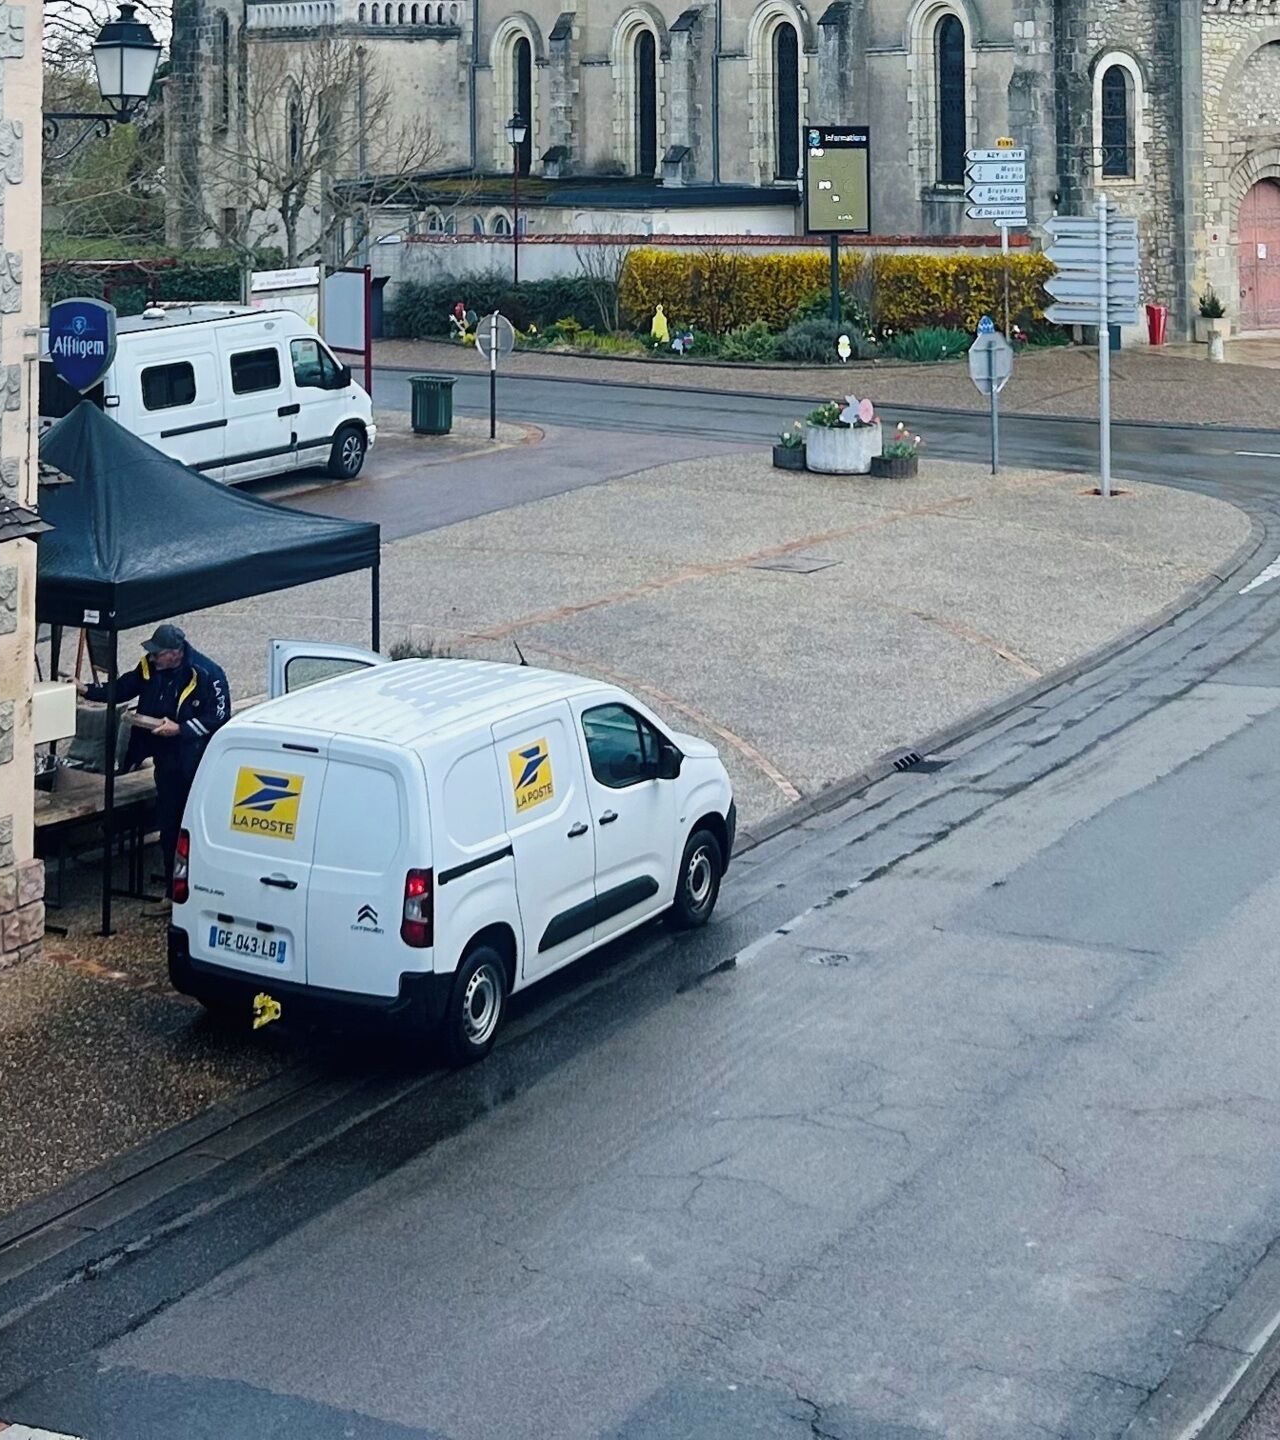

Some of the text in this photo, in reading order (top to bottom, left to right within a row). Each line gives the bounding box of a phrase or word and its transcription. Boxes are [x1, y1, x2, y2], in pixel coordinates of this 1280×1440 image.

[51, 335, 105, 359] Affligem
[516, 782, 553, 808] LA POSTE
[232, 814, 295, 834] LA POSTE
